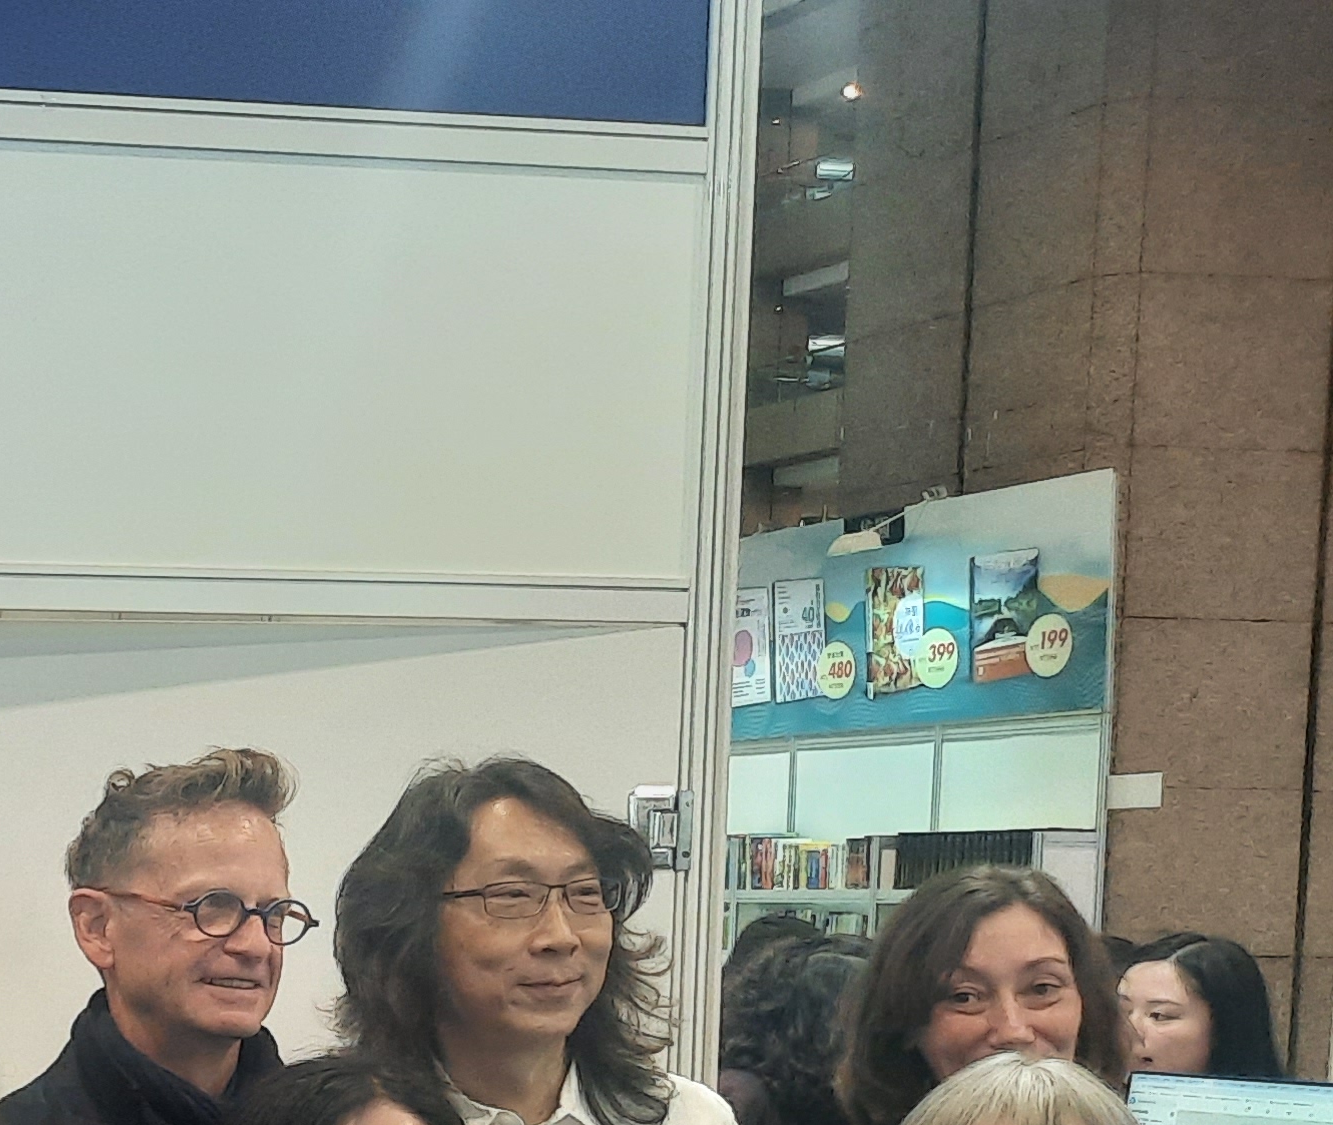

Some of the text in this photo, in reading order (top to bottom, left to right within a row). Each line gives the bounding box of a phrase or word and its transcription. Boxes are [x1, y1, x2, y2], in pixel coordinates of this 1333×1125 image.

[1040, 627, 1069, 650] 199
[928, 641, 955, 663] 399
[828, 659, 853, 679] 480
